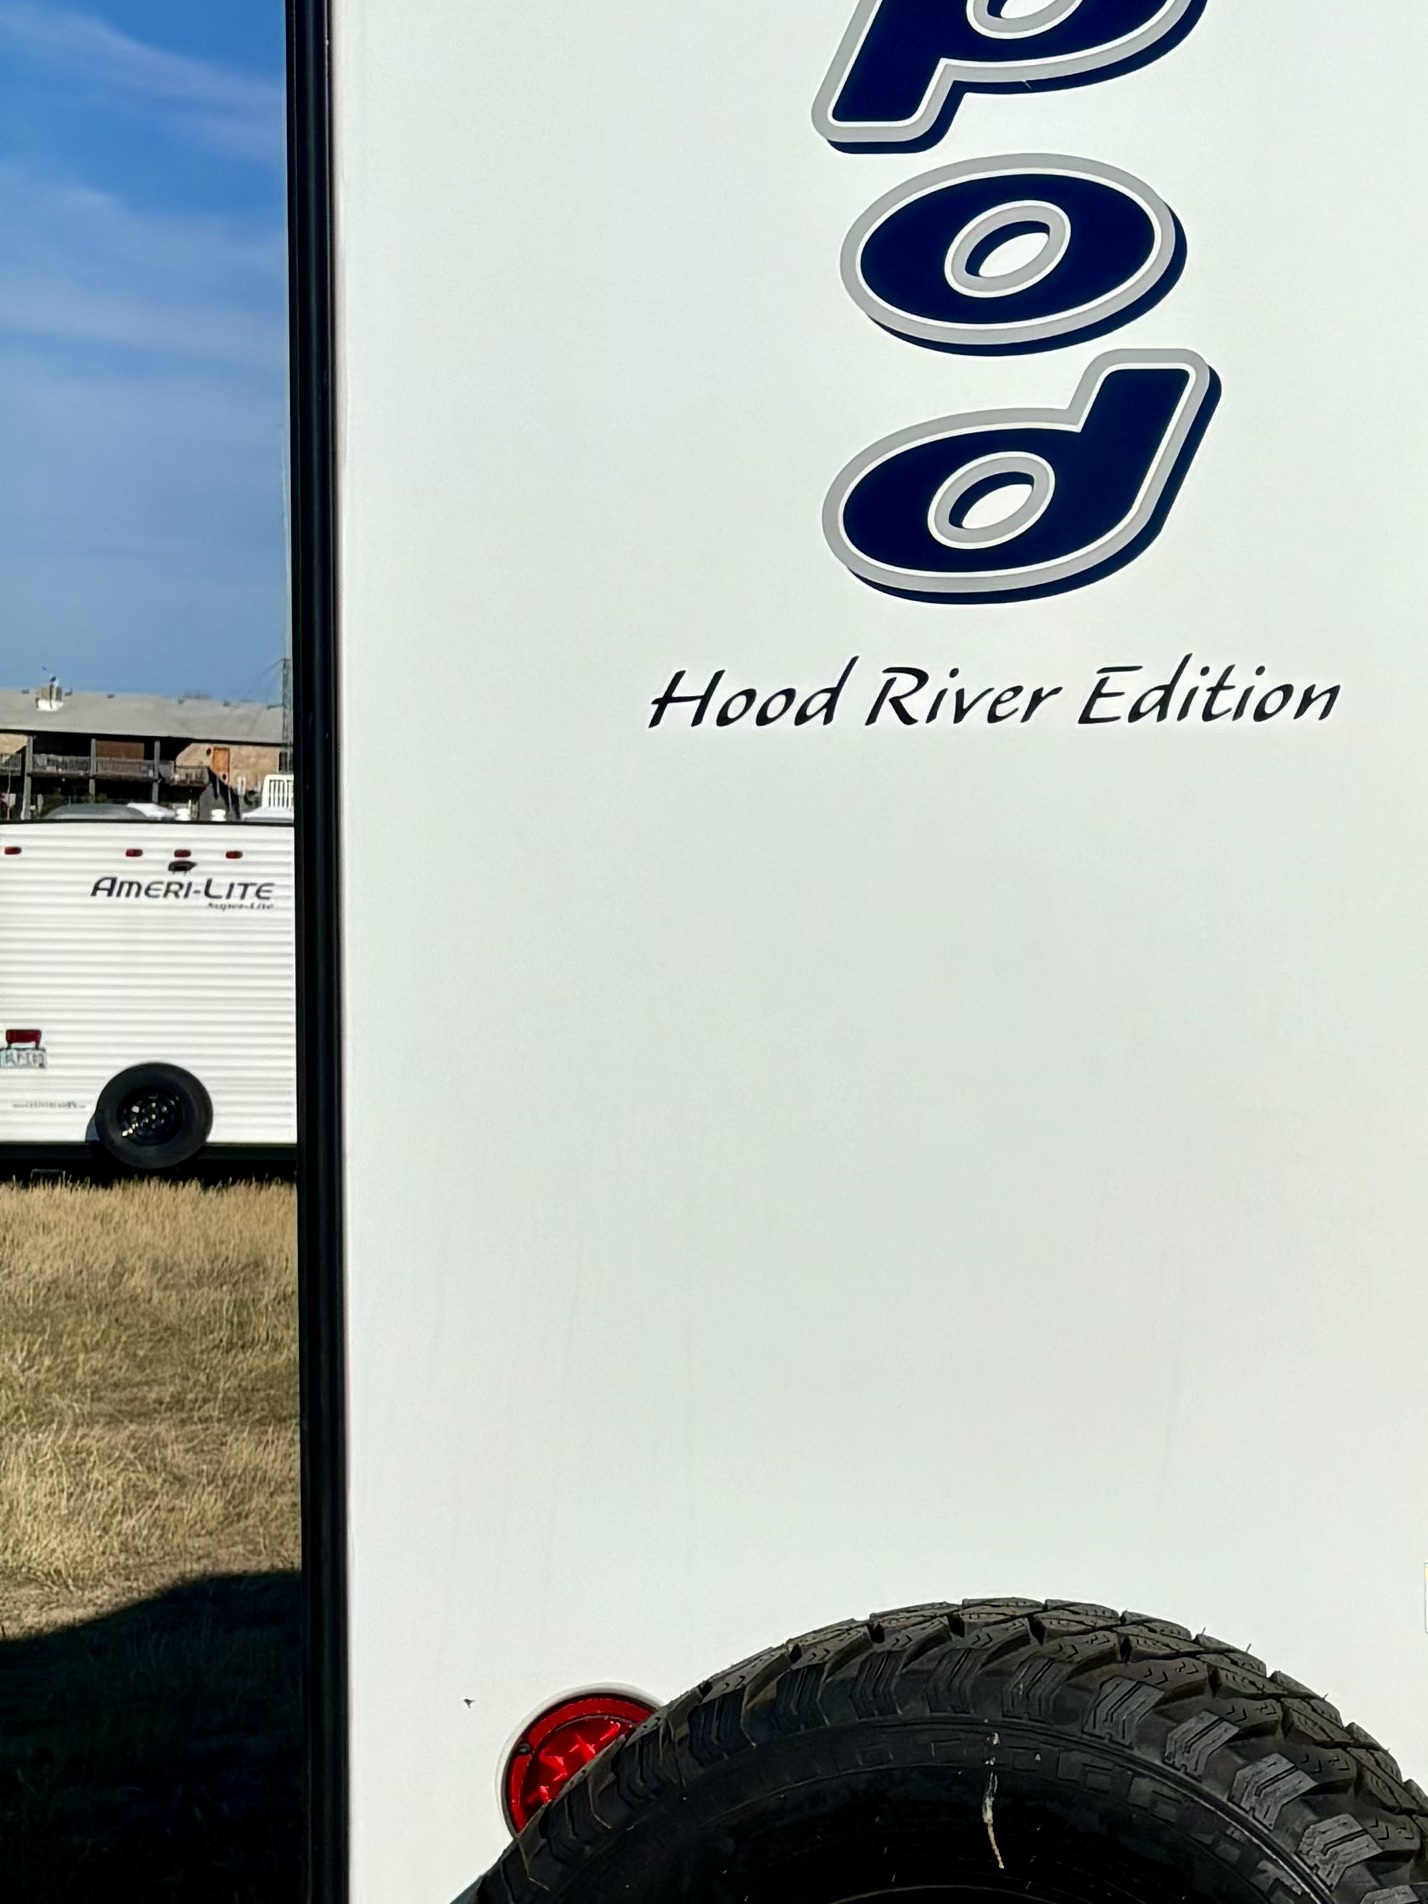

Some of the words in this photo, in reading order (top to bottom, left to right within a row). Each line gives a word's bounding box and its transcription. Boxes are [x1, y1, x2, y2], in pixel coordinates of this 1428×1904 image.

[649, 654, 860, 729] Hood
[865, 665, 1066, 727] River
[1077, 652, 1344, 726] Edition
